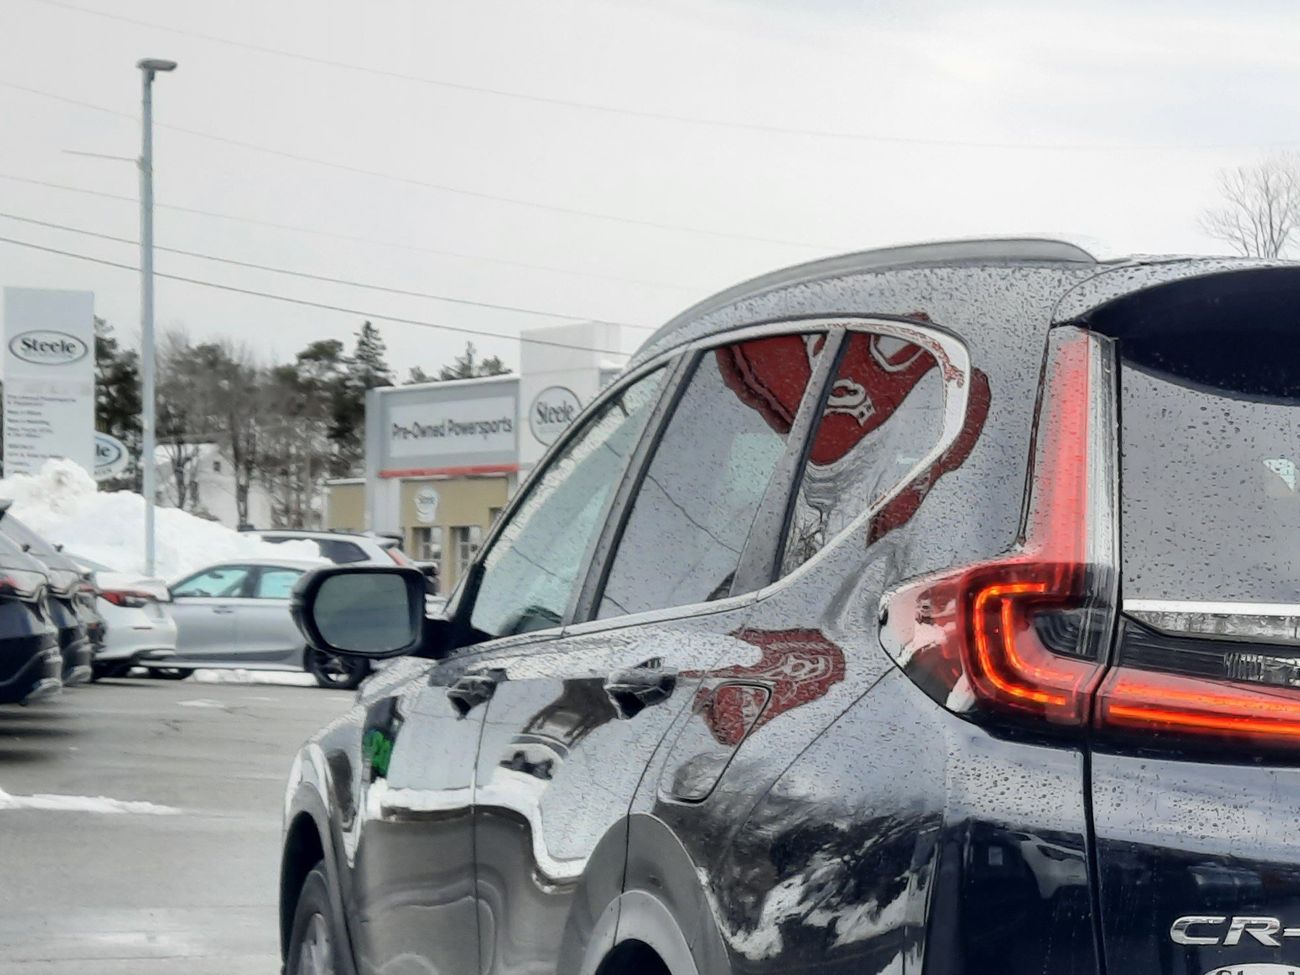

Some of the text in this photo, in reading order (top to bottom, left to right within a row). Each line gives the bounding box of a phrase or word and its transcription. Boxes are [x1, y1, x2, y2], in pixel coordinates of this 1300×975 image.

[21, 338, 76, 354] Steele
[536, 400, 575, 425] Steele
[392, 416, 513, 440] Pre-Owned Powersports
